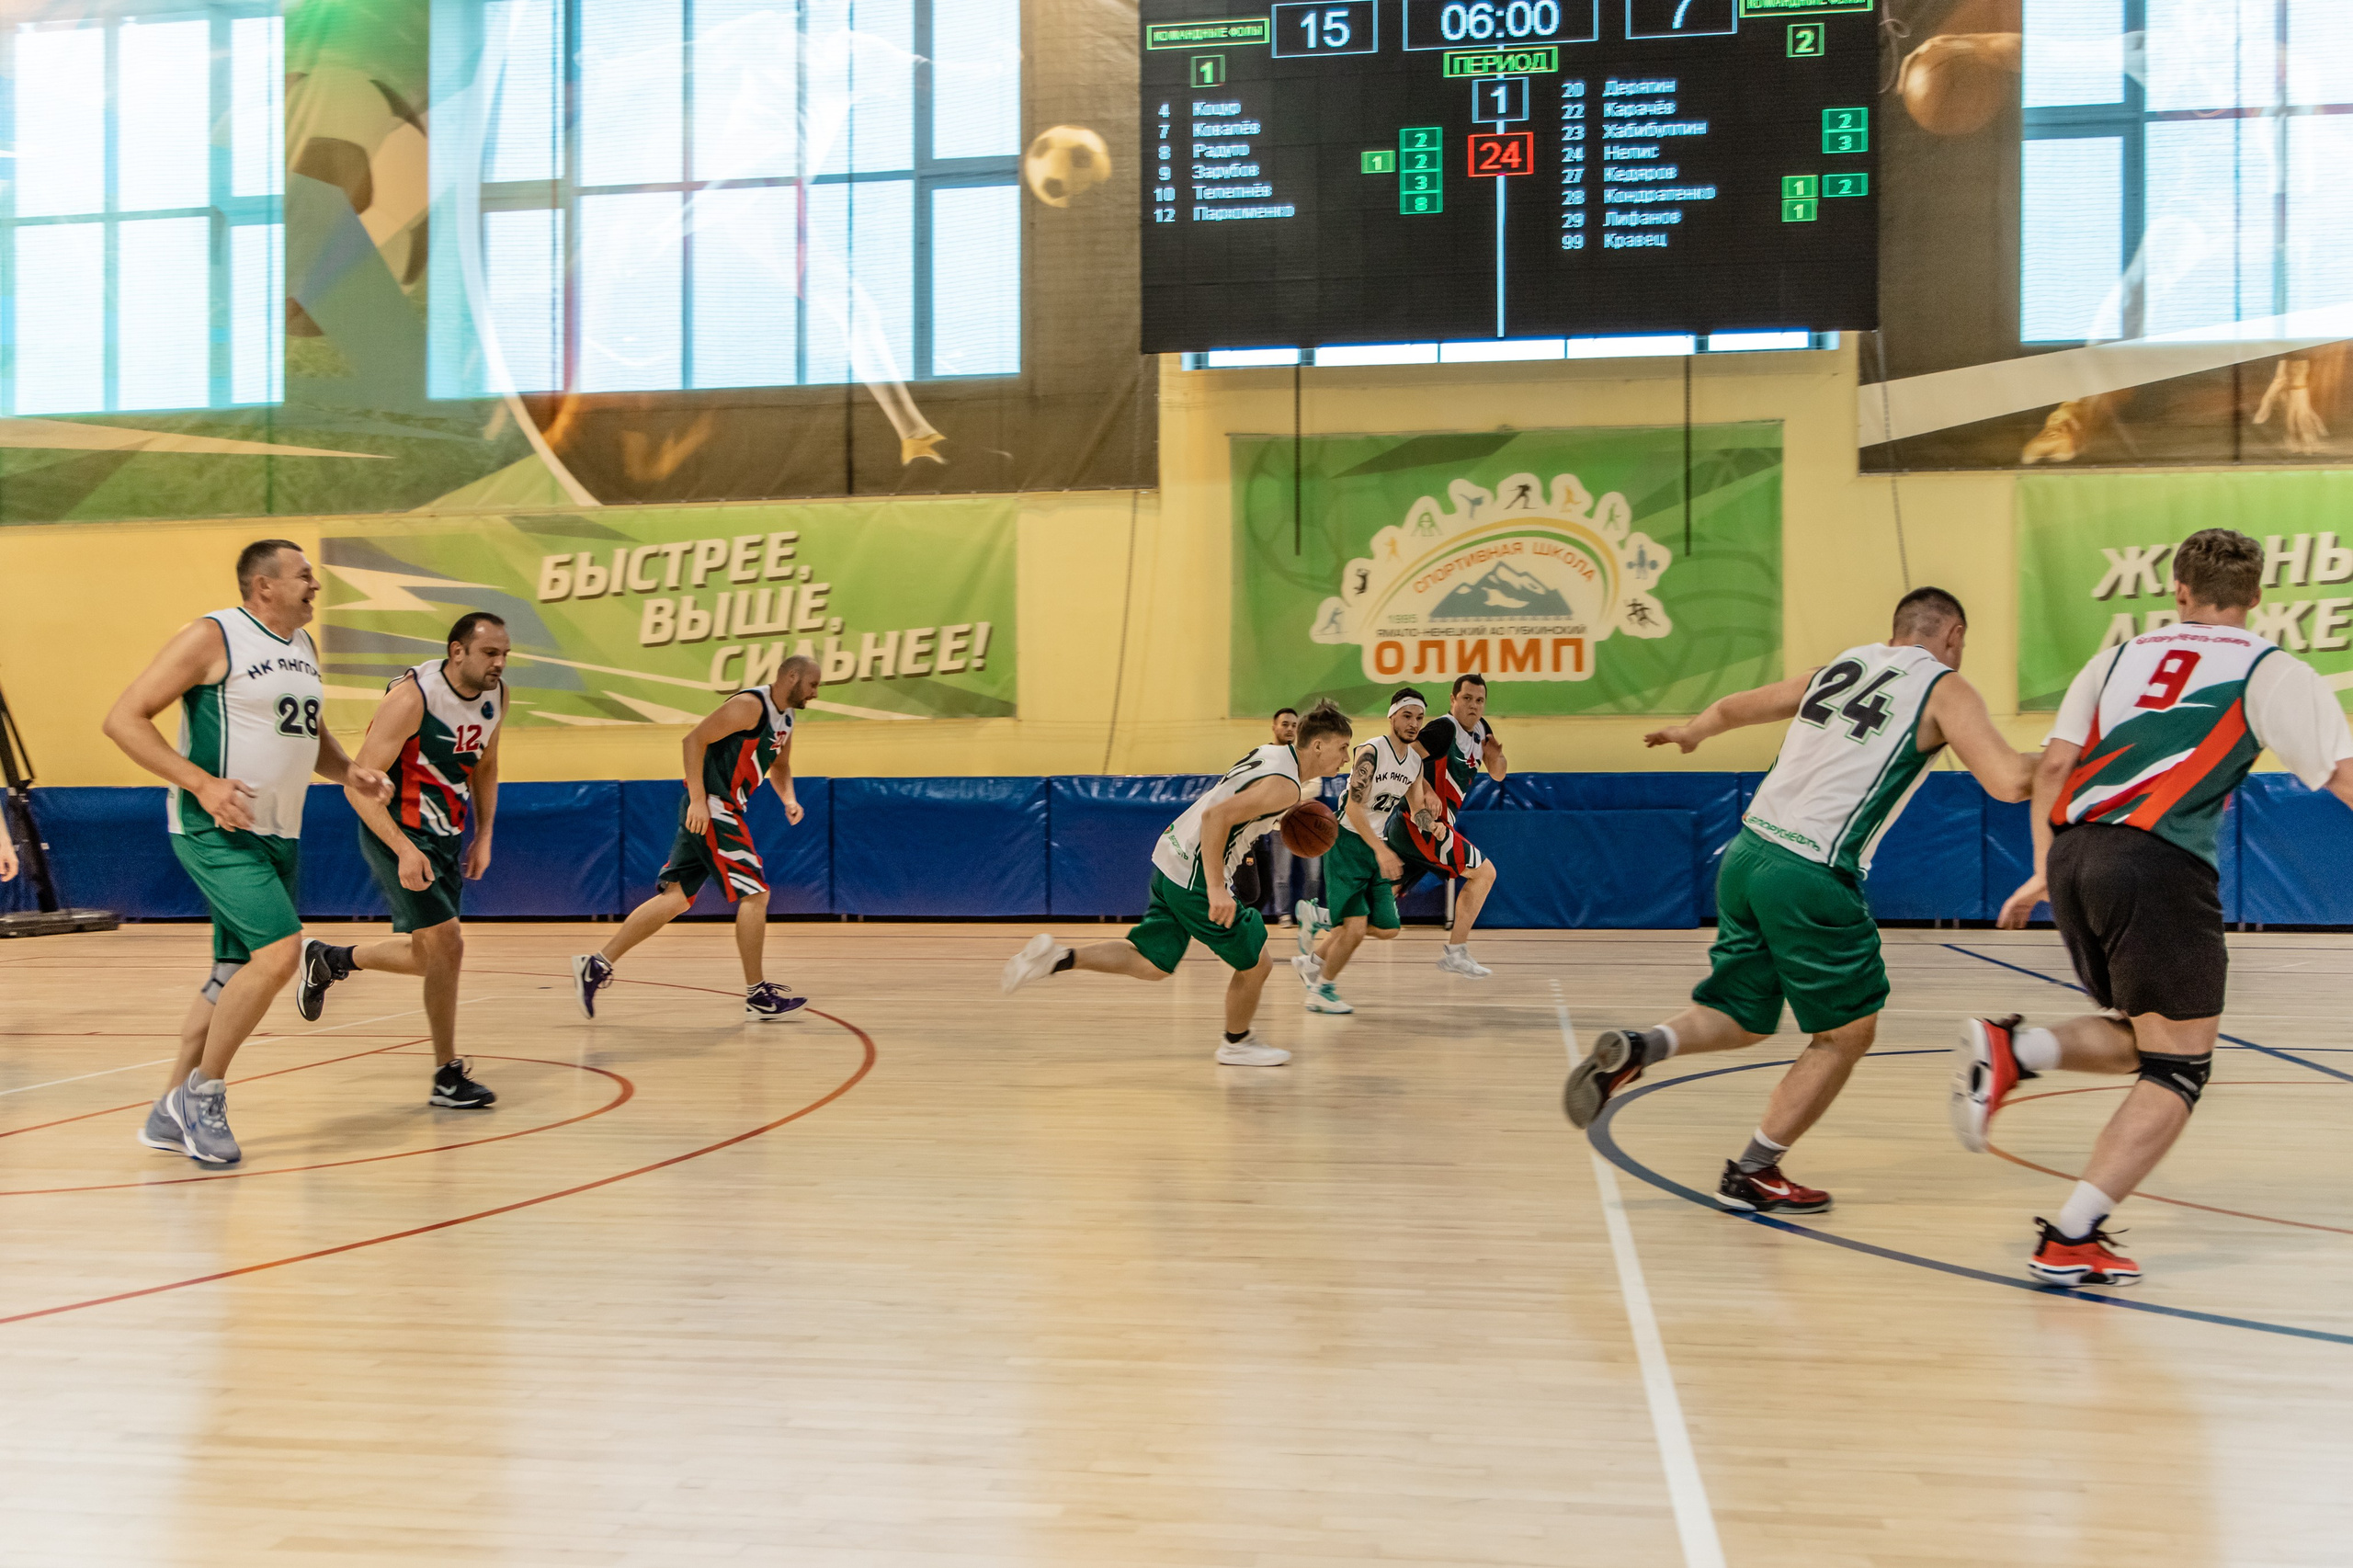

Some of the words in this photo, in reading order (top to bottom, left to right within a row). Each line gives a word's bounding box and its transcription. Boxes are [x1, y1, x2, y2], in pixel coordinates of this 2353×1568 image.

[1300, 8, 1350, 49] 15
[1441, 0, 1561, 41] 06:00
[1795, 30, 1814, 53] 2
[1452, 52, 1548, 74] ПЕРИОД
[1199, 62, 1213, 84] 1
[1562, 82, 1585, 98] 20
[1490, 85, 1506, 114] 1
[1158, 103, 1170, 118] 4
[1562, 104, 1585, 120] 22
[1158, 124, 1171, 139] 7
[1192, 120, 1261, 137] Ковалёв
[1838, 113, 1852, 129] 2
[1415, 132, 1427, 147] 2
[1562, 125, 1585, 141] 23
[1602, 121, 1707, 139] Хабибуллин
[1838, 135, 1852, 151] 3
[1158, 145, 1171, 160] 8
[1479, 141, 1522, 170] 24
[1562, 146, 1585, 163] 24
[1372, 155, 1382, 171] 1
[1415, 154, 1427, 169] 2
[1158, 166, 1171, 181] 9
[1562, 168, 1586, 185] 27
[1415, 176, 1427, 190] 3
[1793, 180, 1804, 196] 1
[1838, 178, 1852, 194] 2
[1153, 187, 1176, 202] 10
[1562, 189, 1586, 206] 28
[1415, 197, 1427, 211] 8
[1793, 203, 1804, 220] 1
[1153, 208, 1176, 223] 12
[1562, 212, 1586, 229] 29
[1562, 234, 1585, 250] 99
[1603, 233, 1668, 250] Кравец
[537, 531, 813, 603] БЫСТРЕЕ,
[1413, 541, 1525, 593] СПОРТИВНАЯ
[1531, 542, 1597, 583] ШКОЛА
[2092, 531, 2353, 600] ЖНЬ
[640, 583, 844, 647] ВЫШЕ,
[1374, 637, 1585, 675] ОЛИМП
[247, 659, 274, 680] НК
[2135, 649, 2201, 710] 9
[1799, 658, 1894, 744] 24
[276, 695, 319, 739] 28
[454, 723, 483, 753] 12
[1375, 772, 1389, 783] НК
